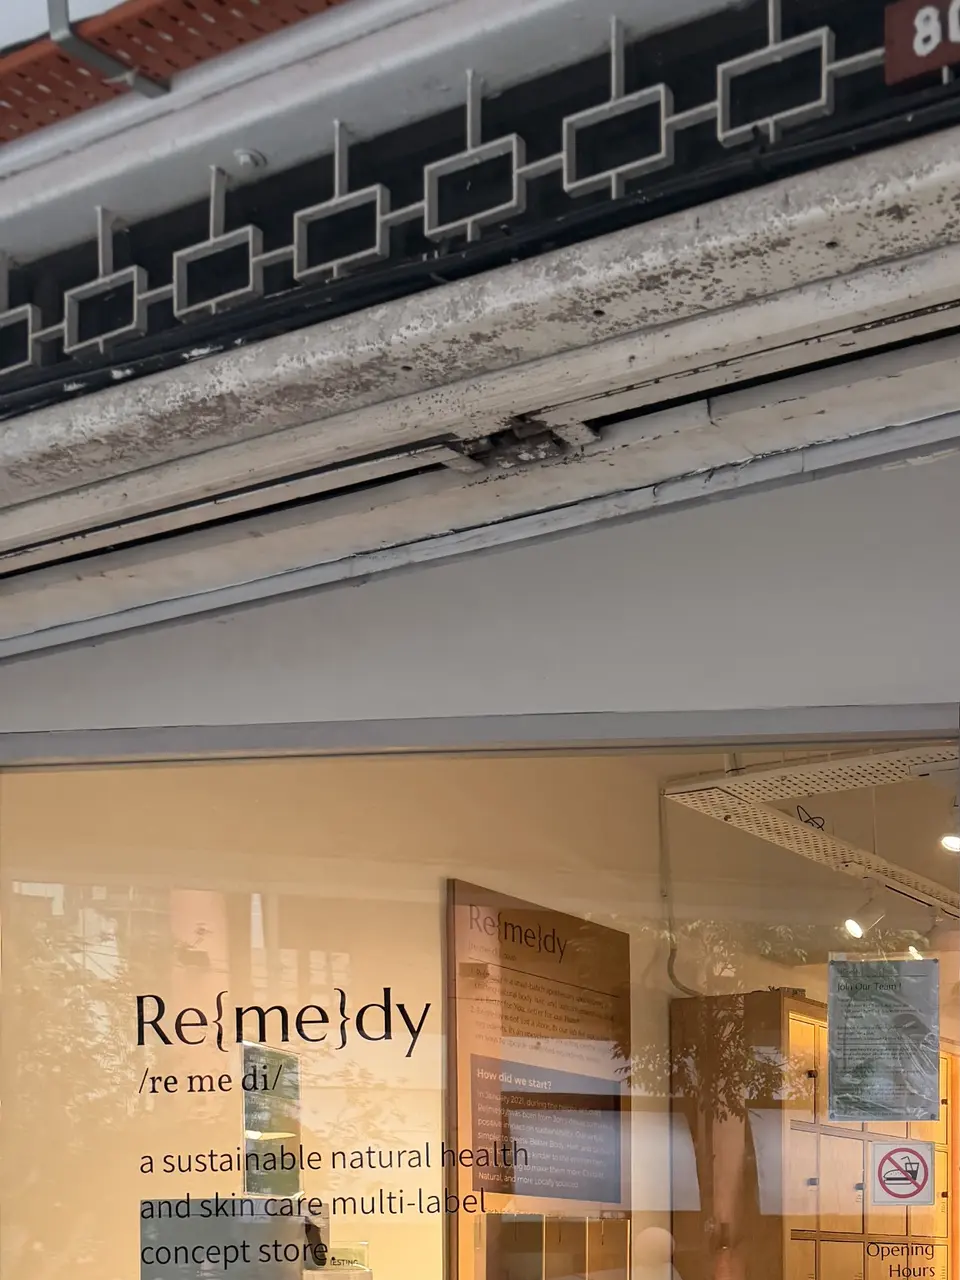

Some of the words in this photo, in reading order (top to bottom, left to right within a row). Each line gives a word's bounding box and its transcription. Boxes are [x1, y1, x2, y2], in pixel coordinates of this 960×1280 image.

[855, 983, 871, 991] Our
[874, 983, 897, 991] Team
[135, 987, 431, 1058] Re{me}dy
[138, 1068, 178, 1094] /re
[187, 1073, 232, 1093] me
[241, 1064, 283, 1092] di/
[477, 1068, 497, 1080] How
[498, 1072, 512, 1084] did
[514, 1077, 527, 1086] we
[528, 1078, 552, 1090] start?
[140, 1155, 154, 1174] a
[163, 1145, 322, 1173] sustainable
[331, 1142, 431, 1170] natural
[441, 1141, 529, 1168] health
[141, 1192, 191, 1219] and
[200, 1191, 254, 1218] skin
[263, 1197, 323, 1217] care
[331, 1188, 486, 1216] multi-label
[141, 1242, 250, 1269] concept
[258, 1239, 336, 1265] store.
[866, 1243, 935, 1260] Opening
[889, 1264, 936, 1278] Hours
